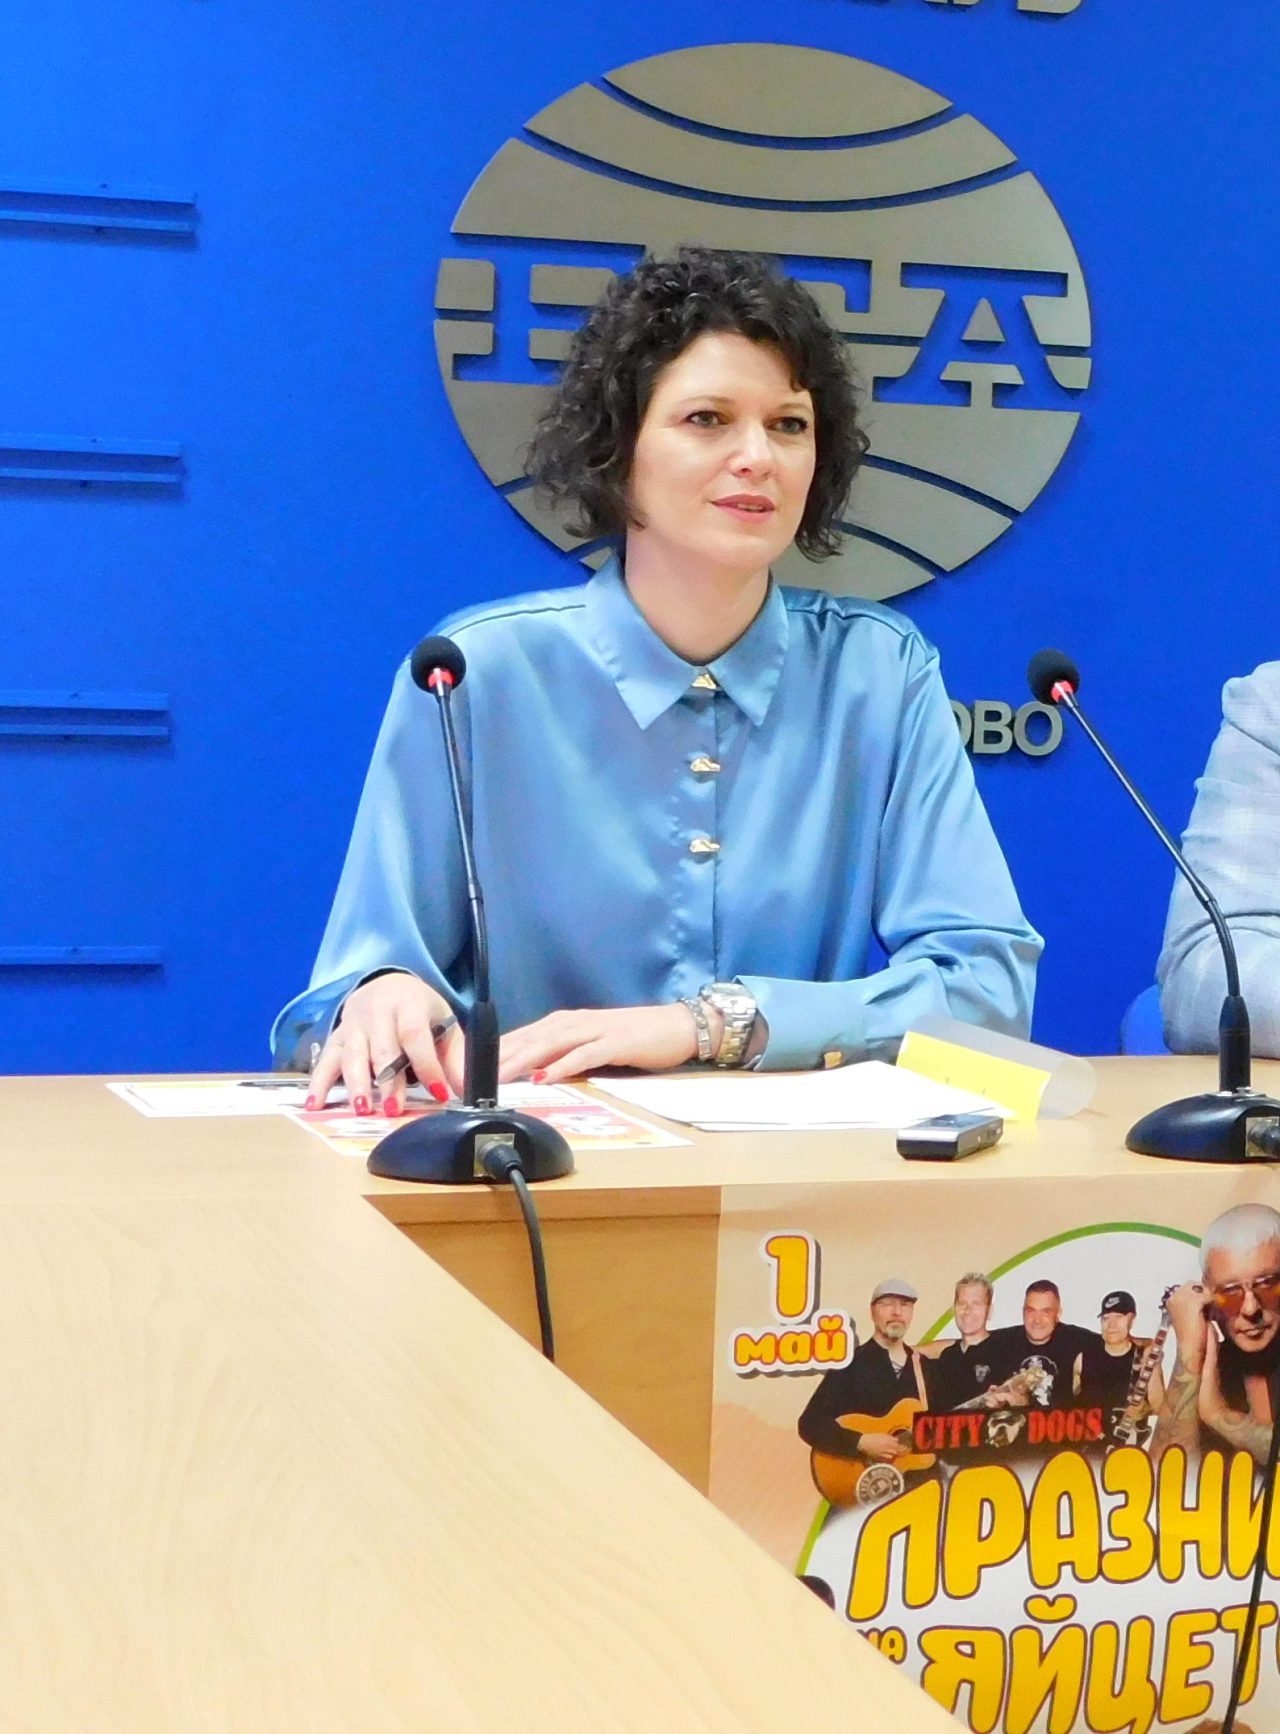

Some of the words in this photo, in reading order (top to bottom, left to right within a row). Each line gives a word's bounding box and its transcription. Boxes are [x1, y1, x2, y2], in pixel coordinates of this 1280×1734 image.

[765, 1235, 810, 1318] 1
[734, 1314, 848, 1366] май
[915, 1414, 986, 1450] CITY
[1028, 1408, 1103, 1444] DOGS
